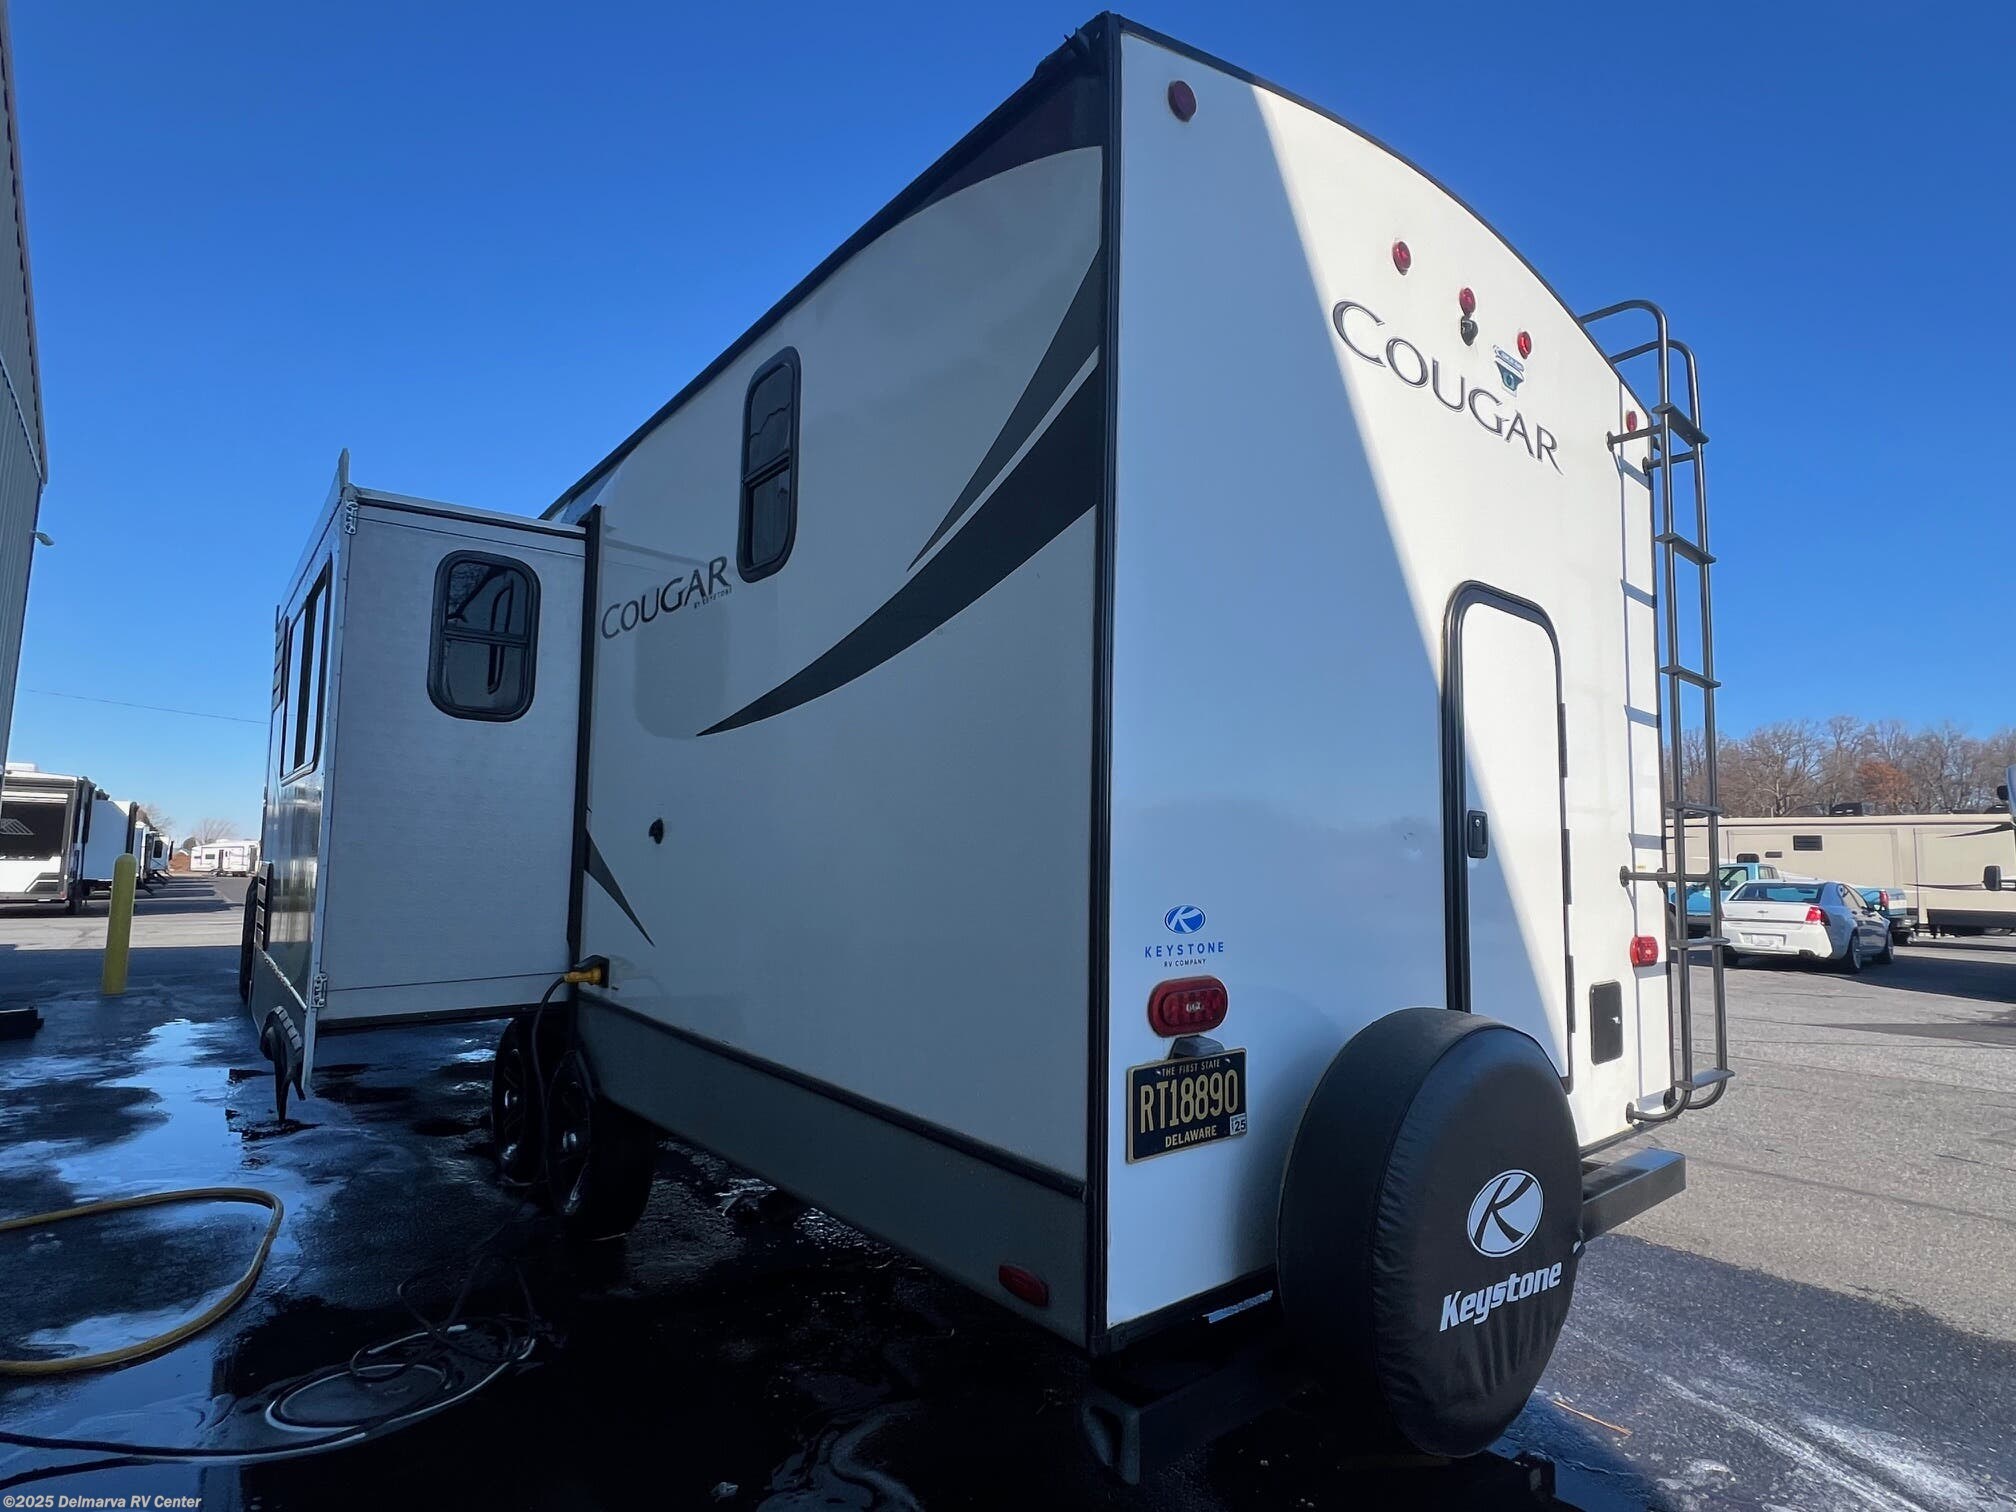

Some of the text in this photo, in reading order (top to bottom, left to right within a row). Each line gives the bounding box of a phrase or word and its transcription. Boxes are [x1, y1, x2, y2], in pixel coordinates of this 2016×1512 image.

[1332, 300, 1563, 476] COUGAR
[601, 556, 730, 639] COUGAR
[1145, 942, 1224, 958] KEYSTONE
[1175, 959, 1206, 967] COMPANY
[1162, 1059, 1220, 1077] THE FIRST STATE
[1140, 1069, 1238, 1133] RT18890
[1165, 1125, 1217, 1148] DELAWARE
[1234, 1120, 1246, 1133] 25
[1439, 1261, 1562, 1331] Keystone
